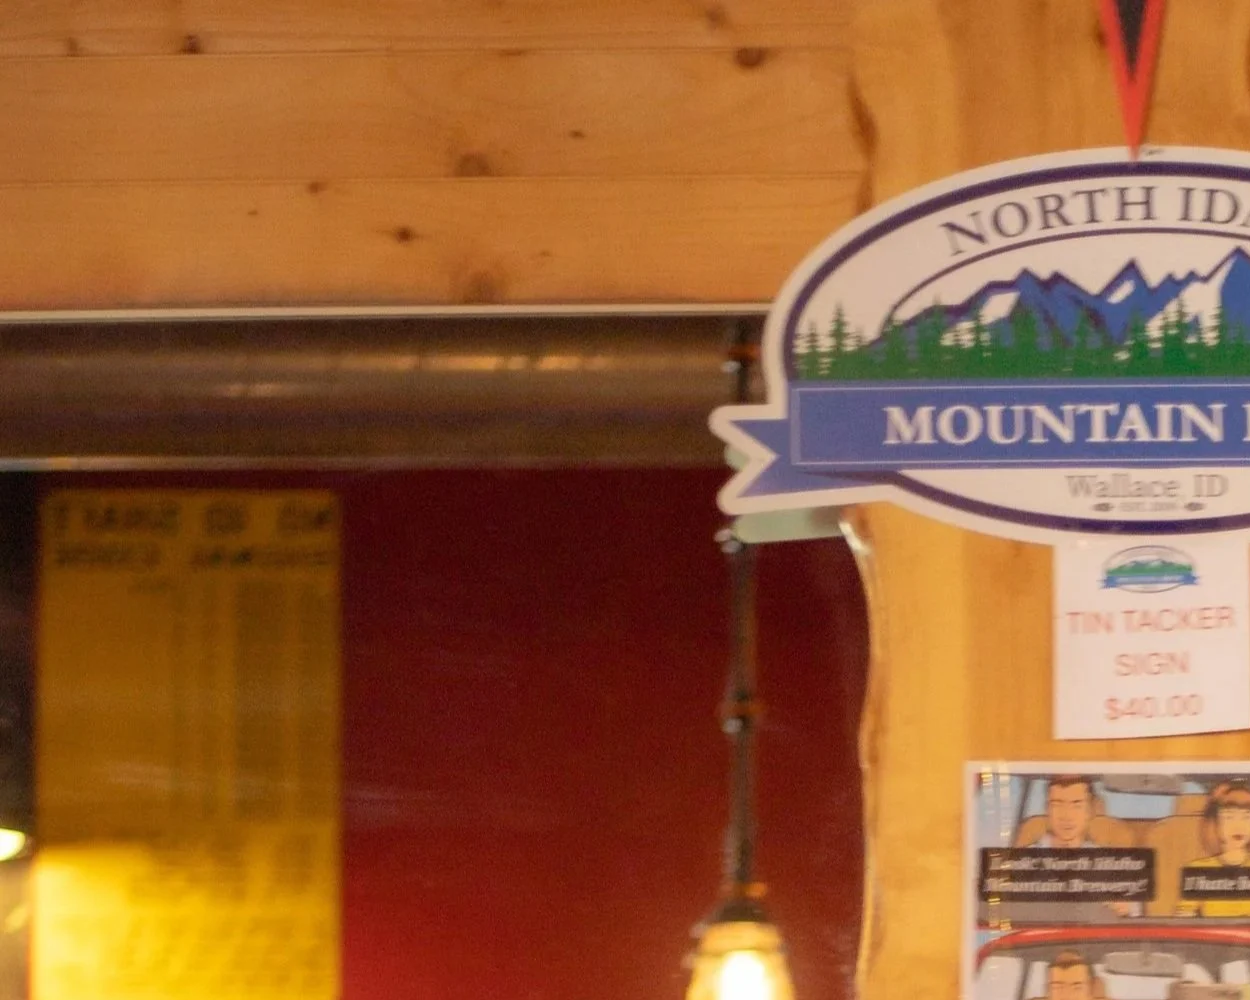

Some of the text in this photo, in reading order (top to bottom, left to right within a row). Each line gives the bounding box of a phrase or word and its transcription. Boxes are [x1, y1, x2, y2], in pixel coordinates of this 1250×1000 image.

[939, 185, 1158, 256] NORTH
[882, 402, 1226, 446] MOUNTAIN
[1193, 474, 1229, 498] ID
[1066, 605, 1235, 634] TIN TACKER
[1114, 652, 1190, 677] SIGN
[1104, 693, 1204, 720] $40.00
[1041, 857, 1093, 871] North
